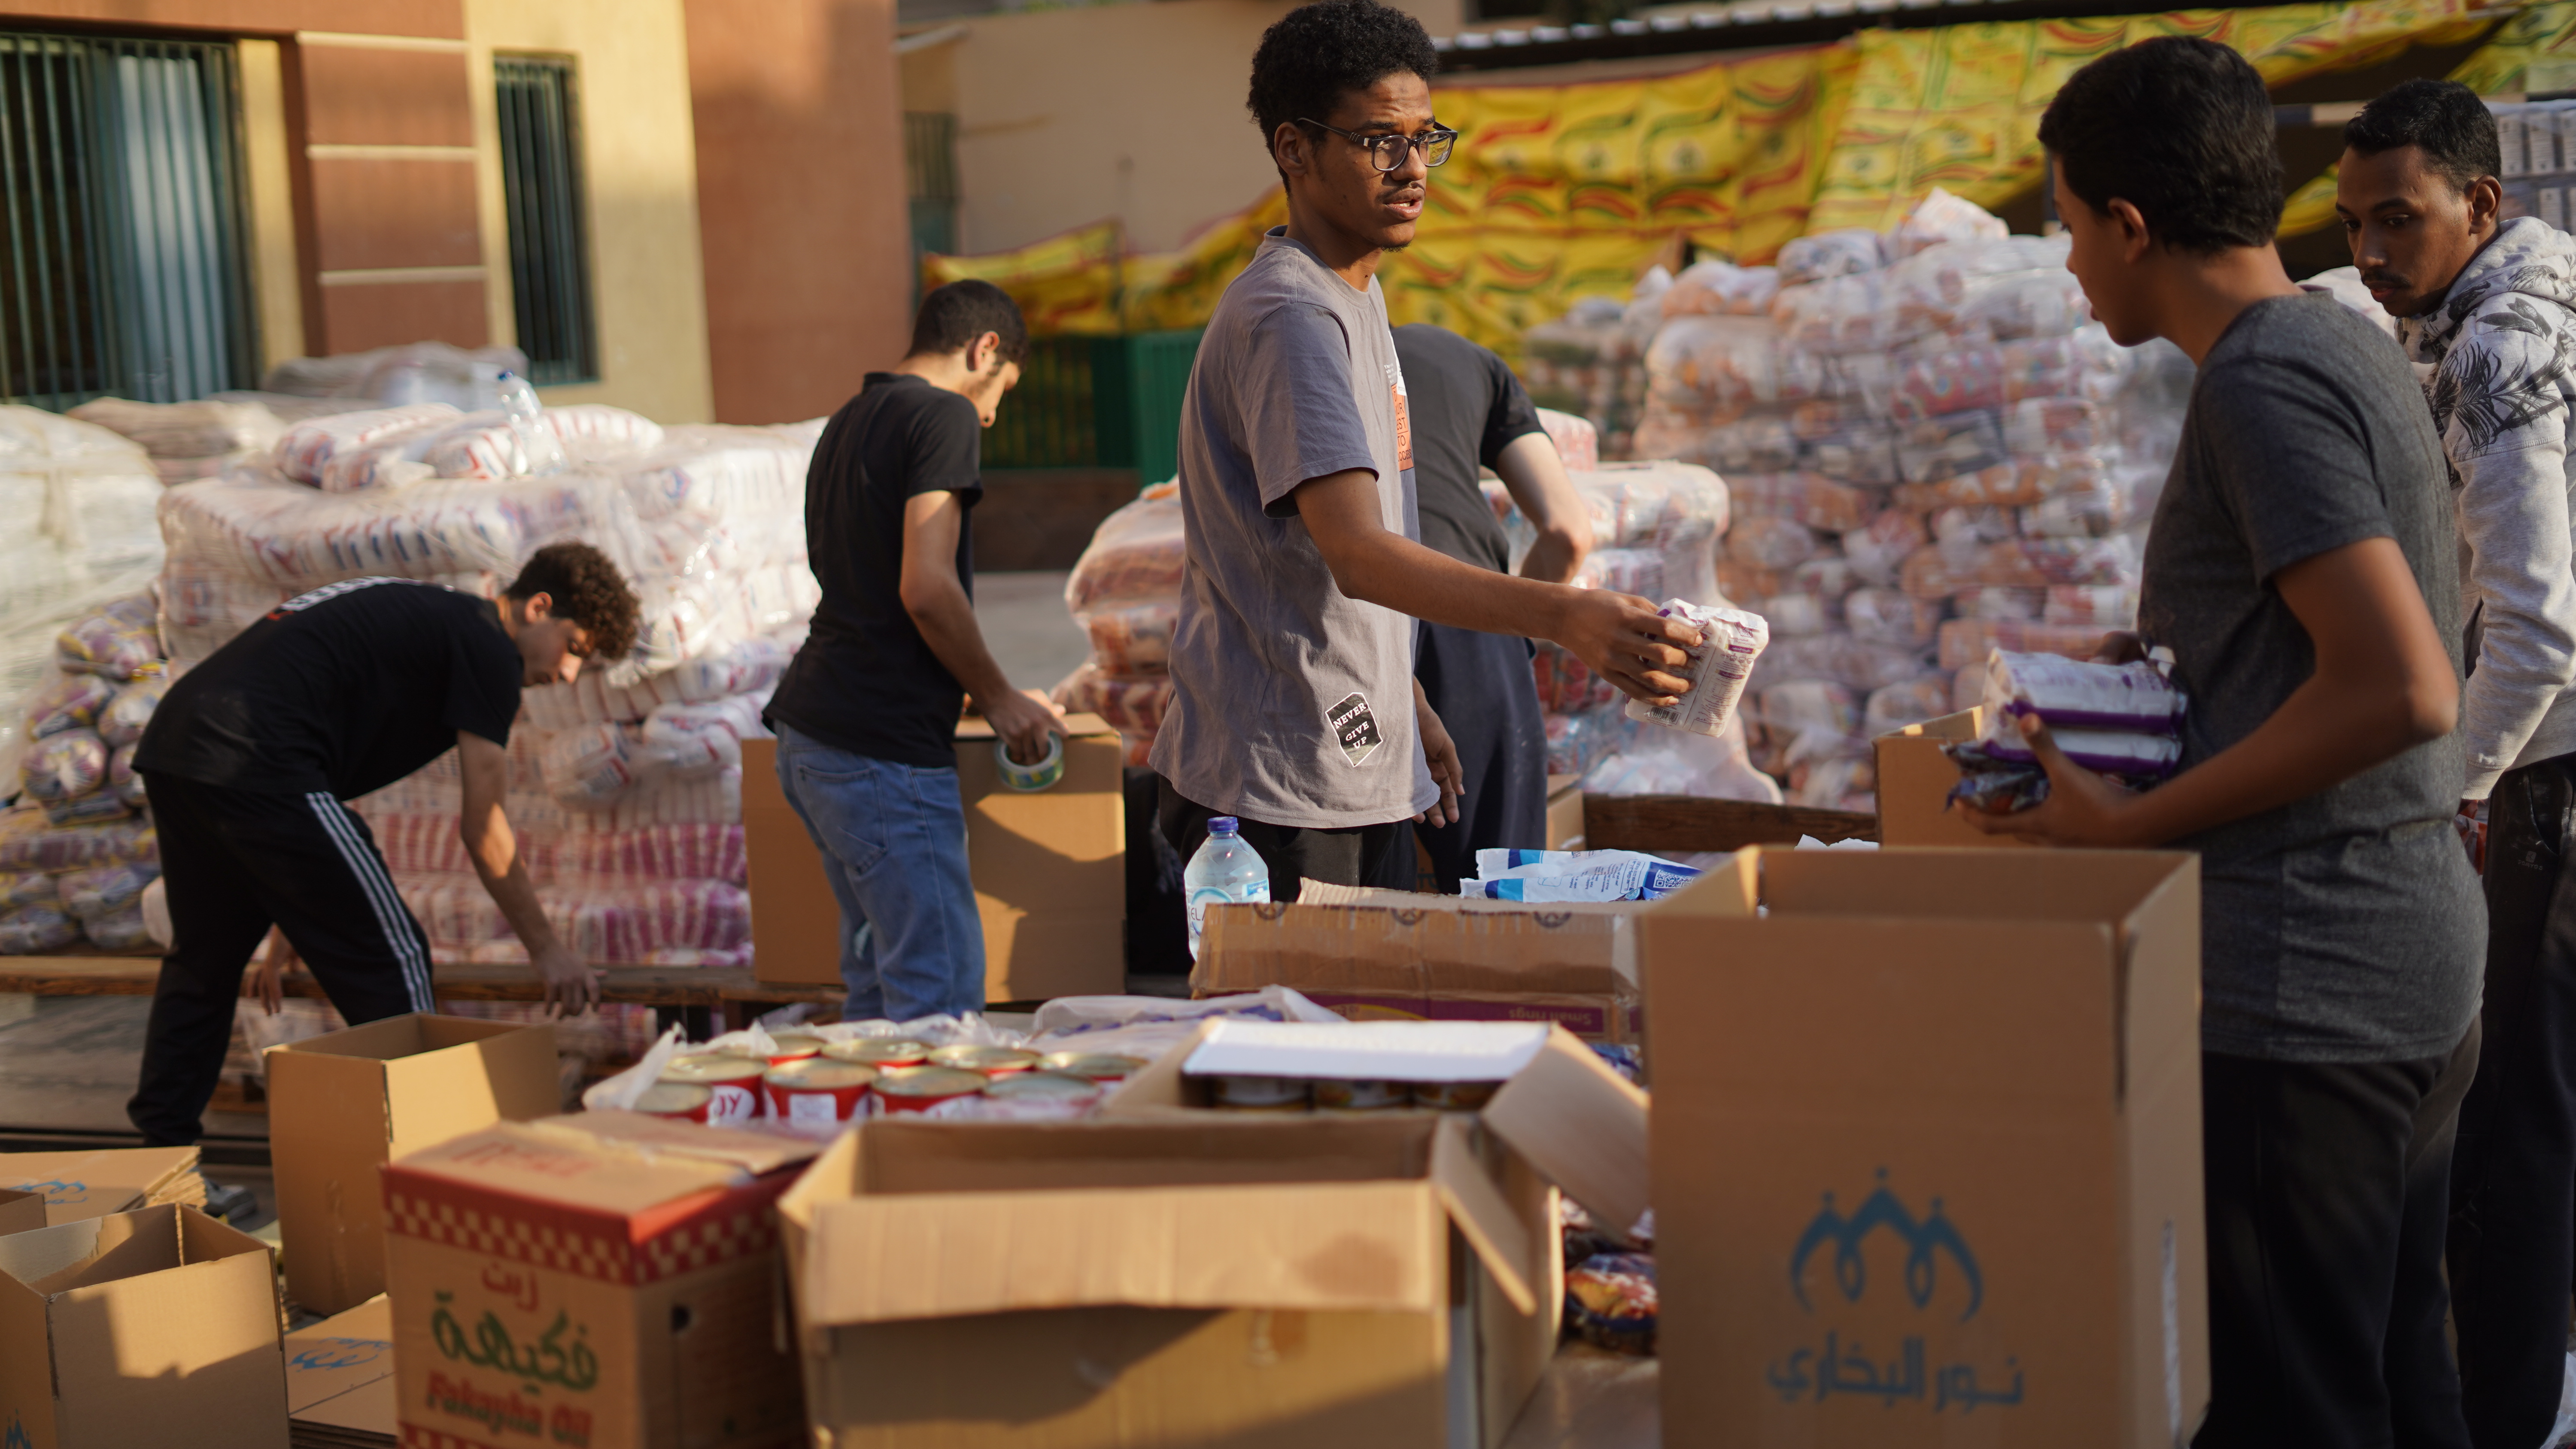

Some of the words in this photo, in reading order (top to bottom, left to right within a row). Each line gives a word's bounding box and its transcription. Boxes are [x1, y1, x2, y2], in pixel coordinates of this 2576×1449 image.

[1397, 417, 1406, 430] EST
[1333, 703, 1367, 729] NEVER
[1346, 721, 1369, 741] GIVE
[1353, 736, 1367, 749] UP
[1766, 1331, 1925, 1409] البخاري
[1933, 1355, 2025, 1414] نور
